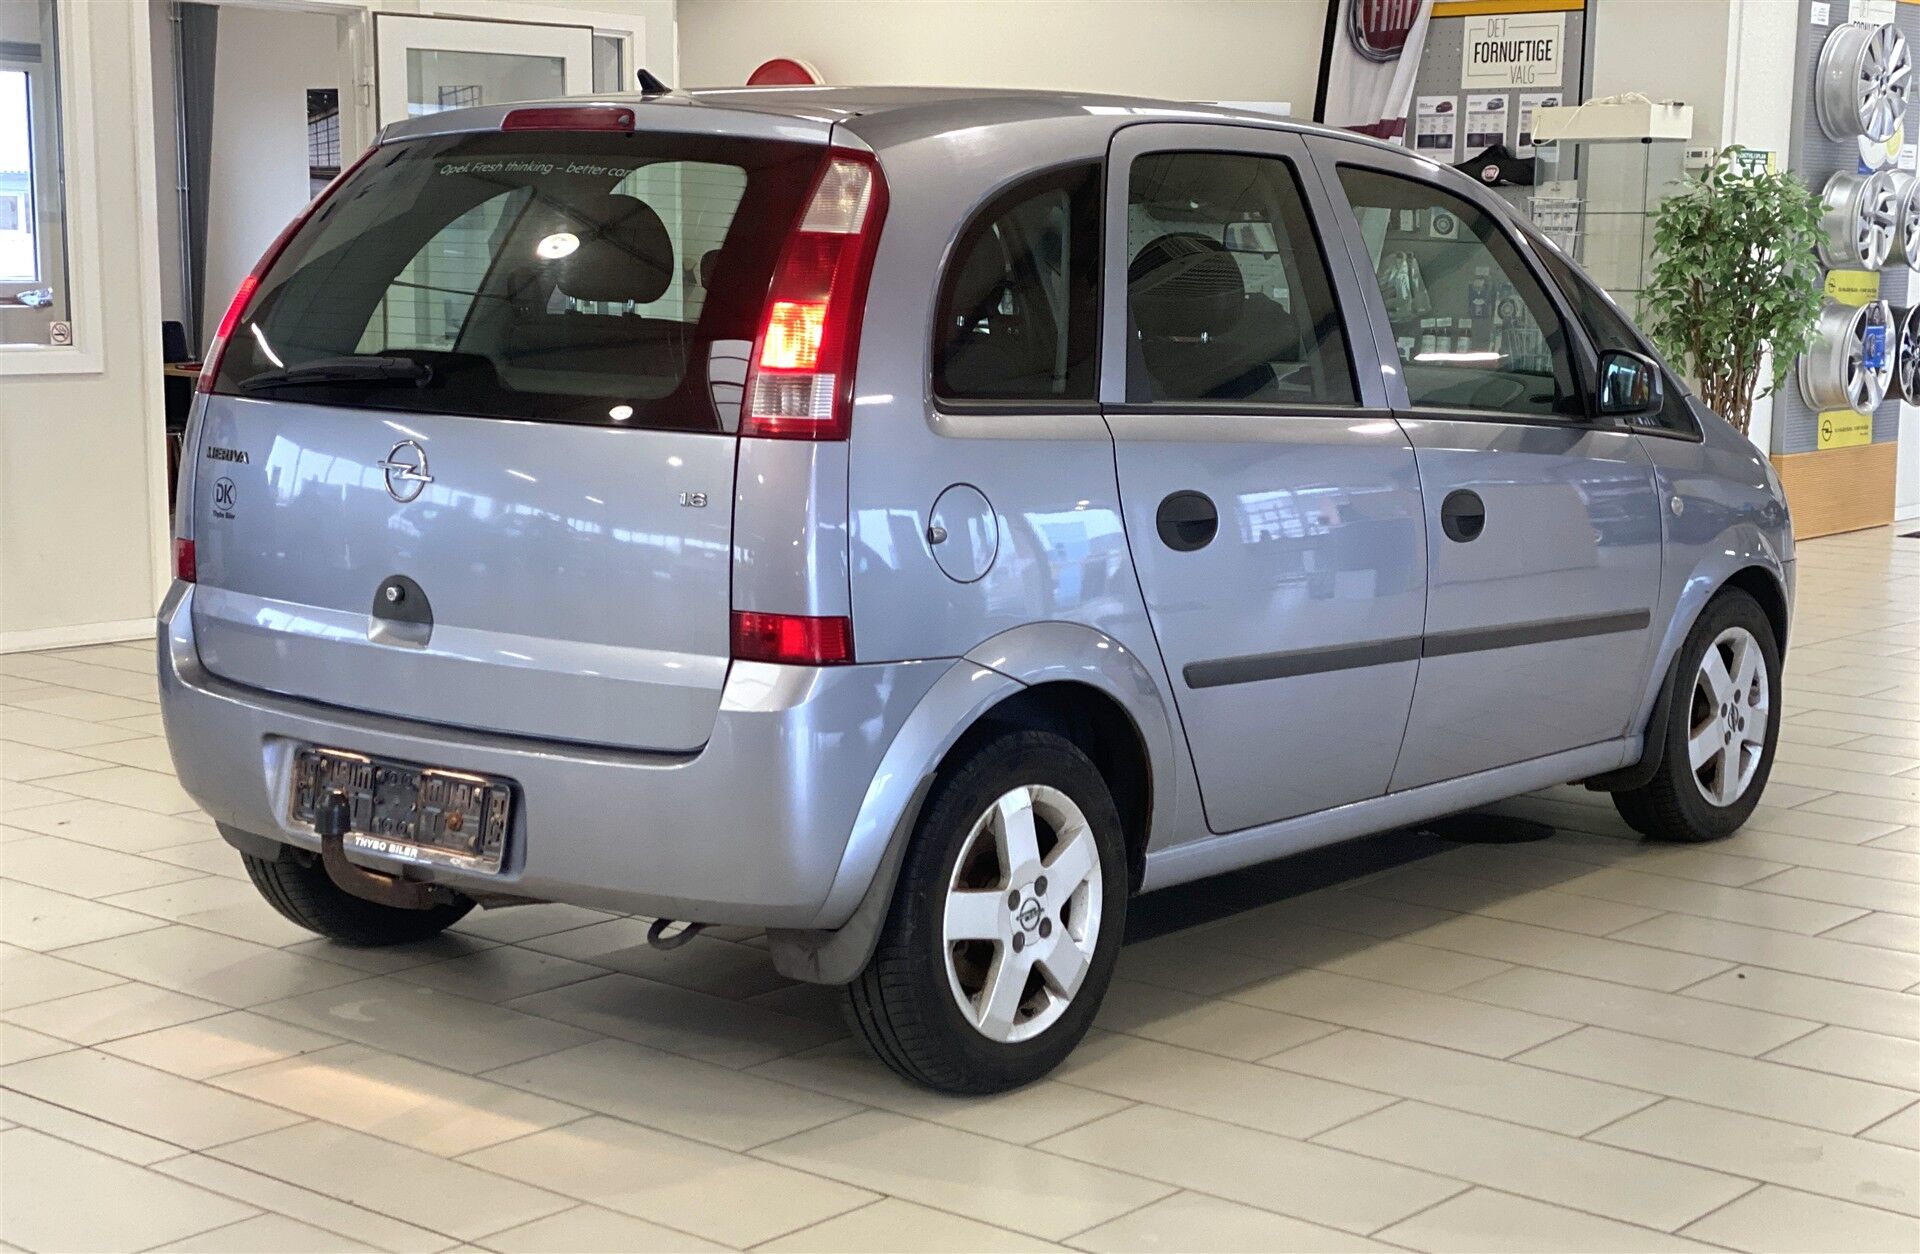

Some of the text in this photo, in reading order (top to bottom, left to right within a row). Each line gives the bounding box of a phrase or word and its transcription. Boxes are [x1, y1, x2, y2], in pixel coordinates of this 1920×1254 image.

[1487, 18, 1509, 38] DET
[1474, 40, 1553, 63] FORNUFTIGE
[1510, 65, 1535, 84] VALG
[471, 161, 502, 173] Fresh
[505, 160, 554, 174] thinking
[566, 162, 606, 175] better
[216, 483, 233, 504] DK
[355, 836, 418, 858] THYBO BILER
